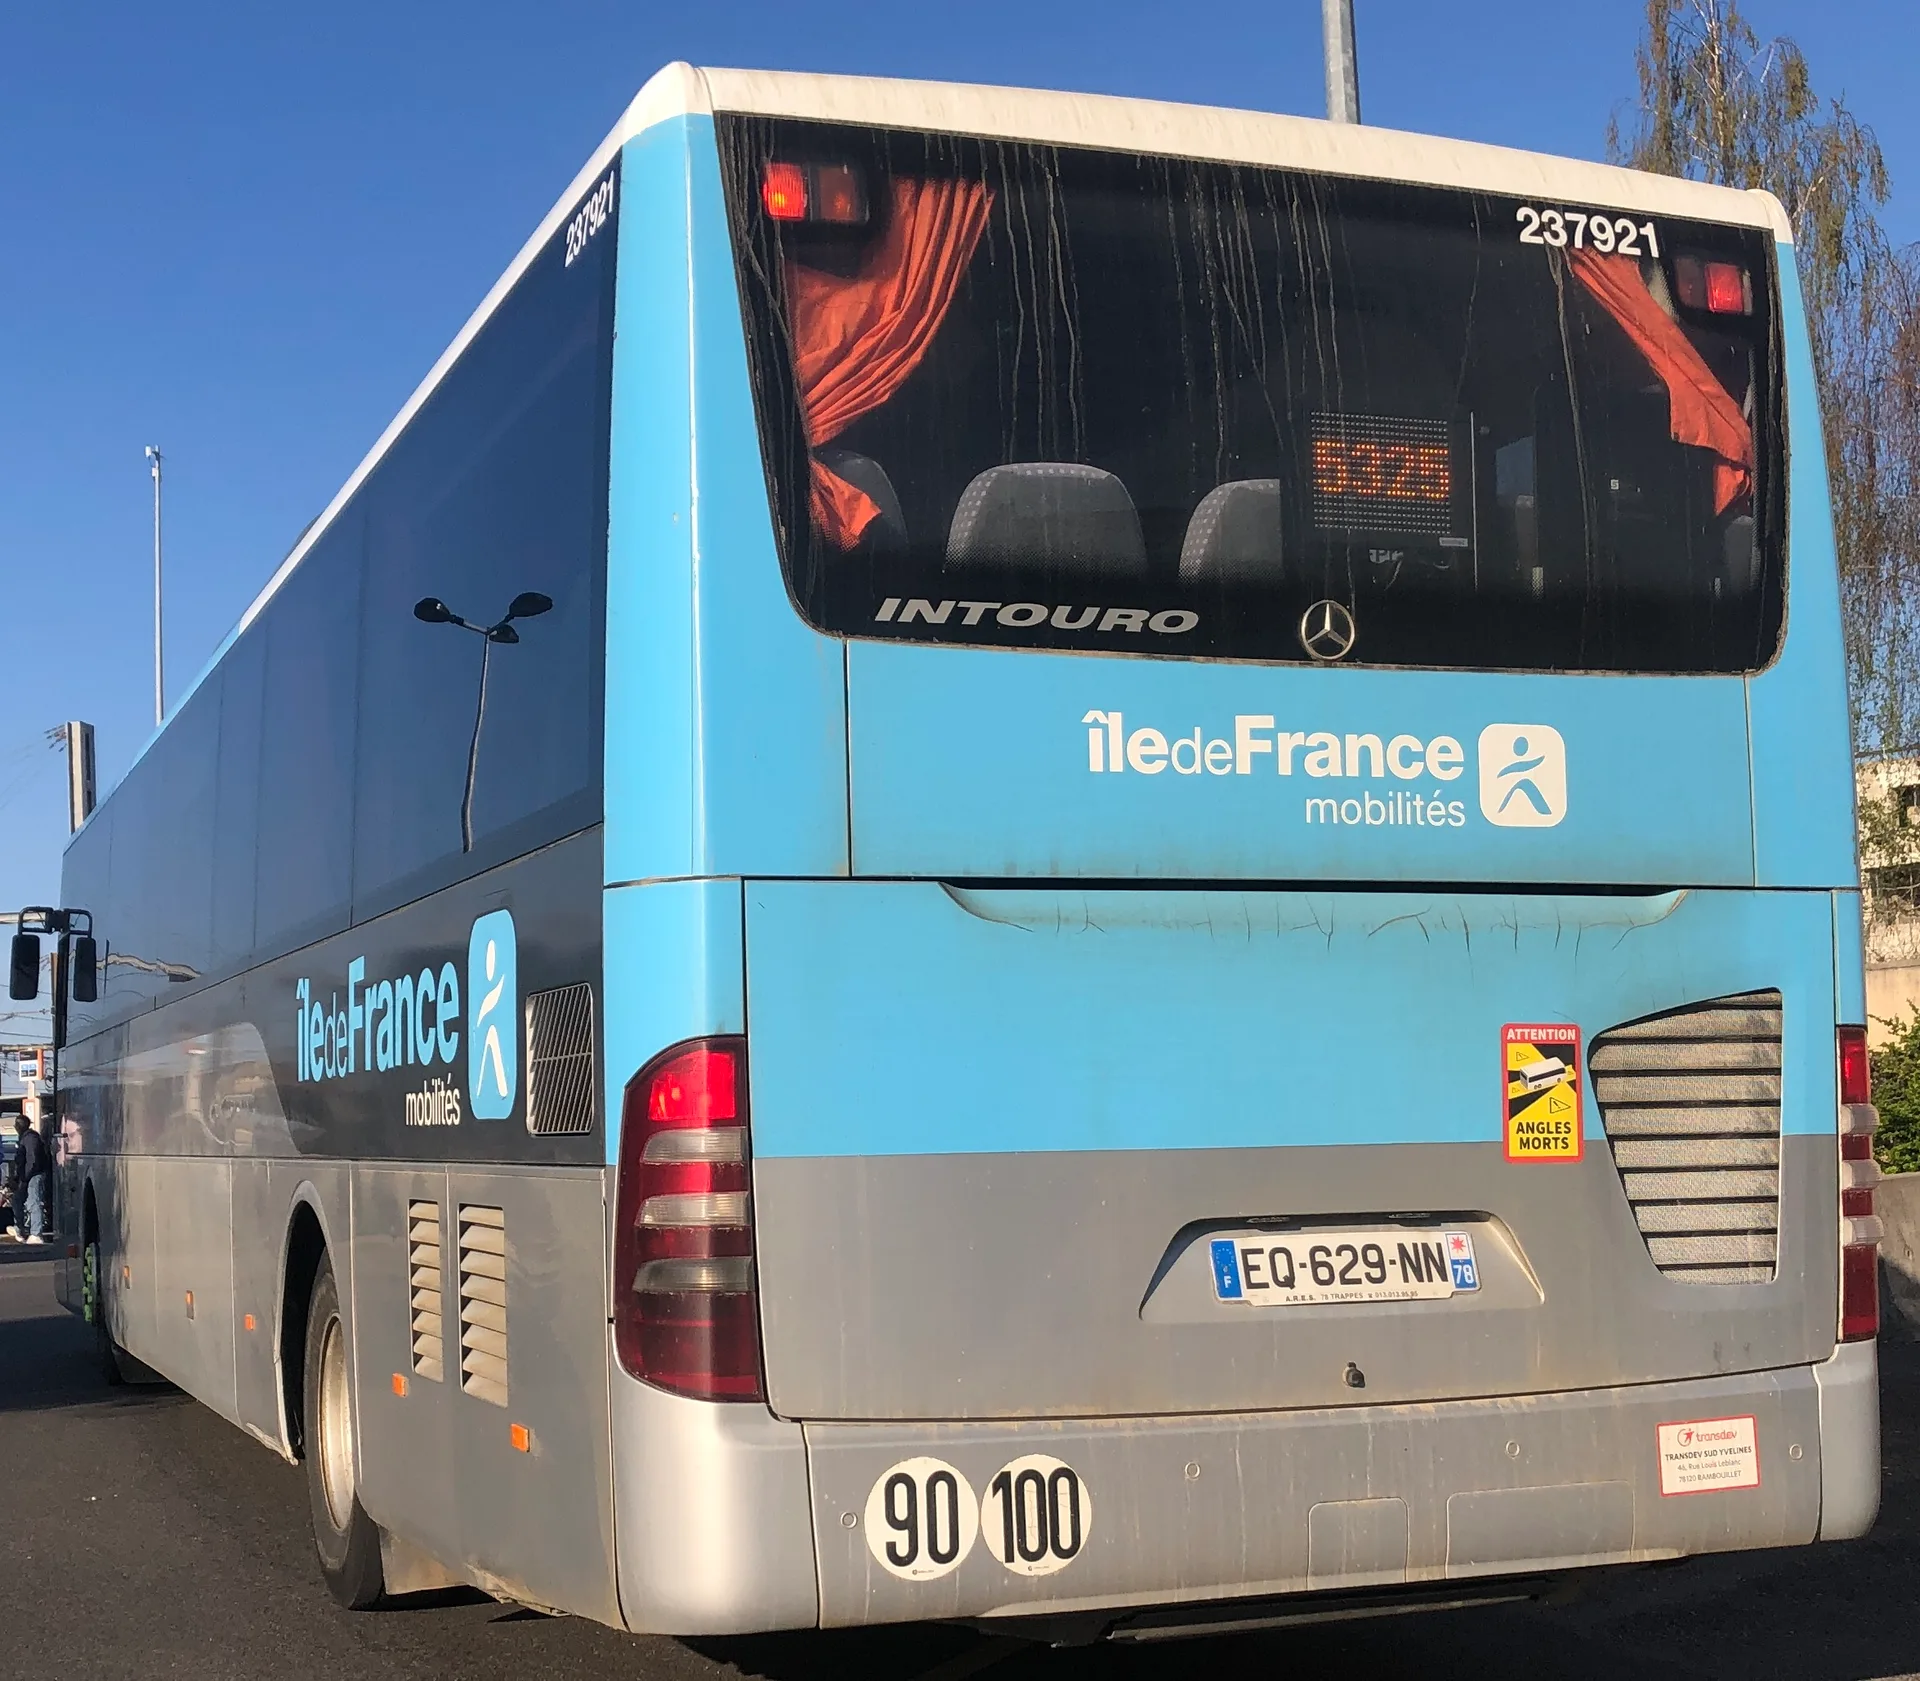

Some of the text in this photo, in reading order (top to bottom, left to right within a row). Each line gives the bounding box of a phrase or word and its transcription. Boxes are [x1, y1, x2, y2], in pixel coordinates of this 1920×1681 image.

[564, 170, 615, 268] 237921
[1516, 206, 1660, 258] 237921
[1315, 440, 1449, 499] 5325
[874, 597, 1200, 634] INTOURO
[1305, 788, 1466, 827] mobilités
[1506, 1028, 1576, 1041] ATTENTION
[405, 1072, 461, 1127] mobilités
[1515, 1121, 1572, 1135] ANGLES
[1519, 1136, 1570, 1150] MORTS
[1240, 1242, 1450, 1291] EQ-629-NN
[1452, 1264, 1475, 1285] 78
[1223, 1275, 1232, 1289] F
[1330, 1291, 1364, 1300] TRAPPES
[1695, 1429, 1738, 1442] transdev
[1665, 1445, 1752, 1462] TRANSDEV SUD YVELINES
[1701, 1460, 1717, 1469] Louis
[1697, 1470, 1742, 1481] RAMBOUILLET
[884, 1469, 960, 1568] 90
[991, 1466, 1082, 1564] 100
